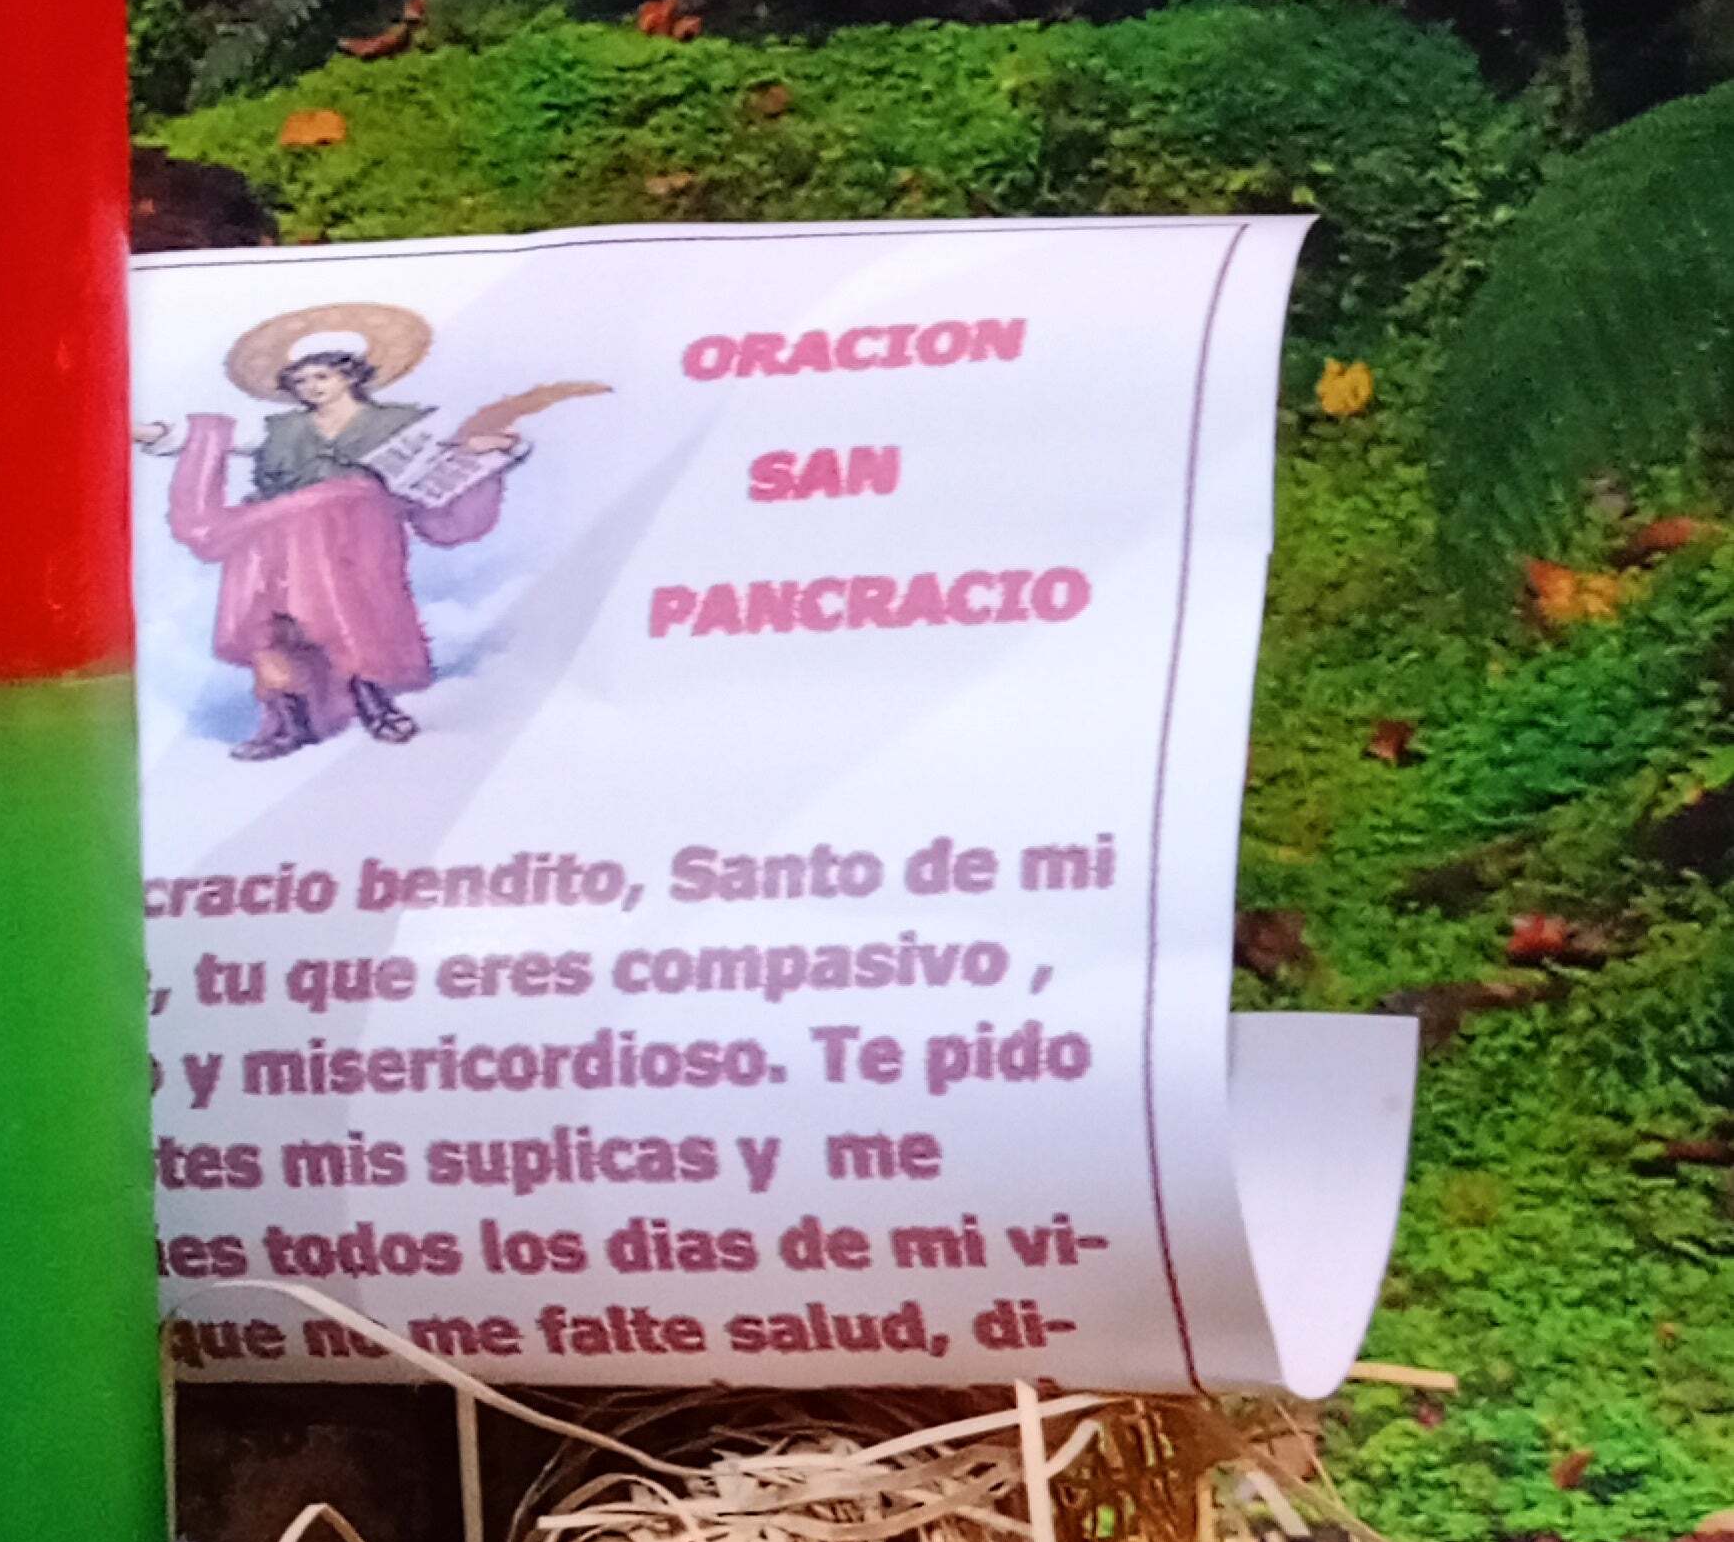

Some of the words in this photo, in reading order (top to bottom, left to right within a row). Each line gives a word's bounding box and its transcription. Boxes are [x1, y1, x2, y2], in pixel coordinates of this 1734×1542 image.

[681, 317, 1026, 381] ORACION
[748, 444, 901, 503] SAN
[648, 566, 1092, 639] PANCRACIO
[357, 852, 644, 911] bendito,
[669, 845, 884, 902] Santo
[905, 836, 999, 895] de
[1021, 832, 1115, 891] mi
[195, 953, 266, 1005] tu
[287, 955, 416, 1012] que
[436, 951, 593, 998] eres
[183, 1053, 222, 1108] y
[242, 1027, 787, 1095] misericordioso.
[810, 1025, 903, 1084] Te
[926, 1020, 1091, 1095] pido
[282, 1131, 408, 1188] mis
[427, 1125, 718, 1195] suplicas
[737, 1136, 781, 1192] y
[826, 1132, 941, 1180] me
[264, 1222, 463, 1279] todos
[481, 1218, 587, 1275] los
[606, 1217, 758, 1273] dias
[779, 1215, 872, 1270] de
[890, 1213, 986, 1267] mi
[1007, 1213, 1109, 1266] vi-
[408, 1315, 522, 1357] me
[536, 1304, 706, 1355] falte
[725, 1300, 950, 1357] salud,
[973, 1299, 1076, 1349] di-
